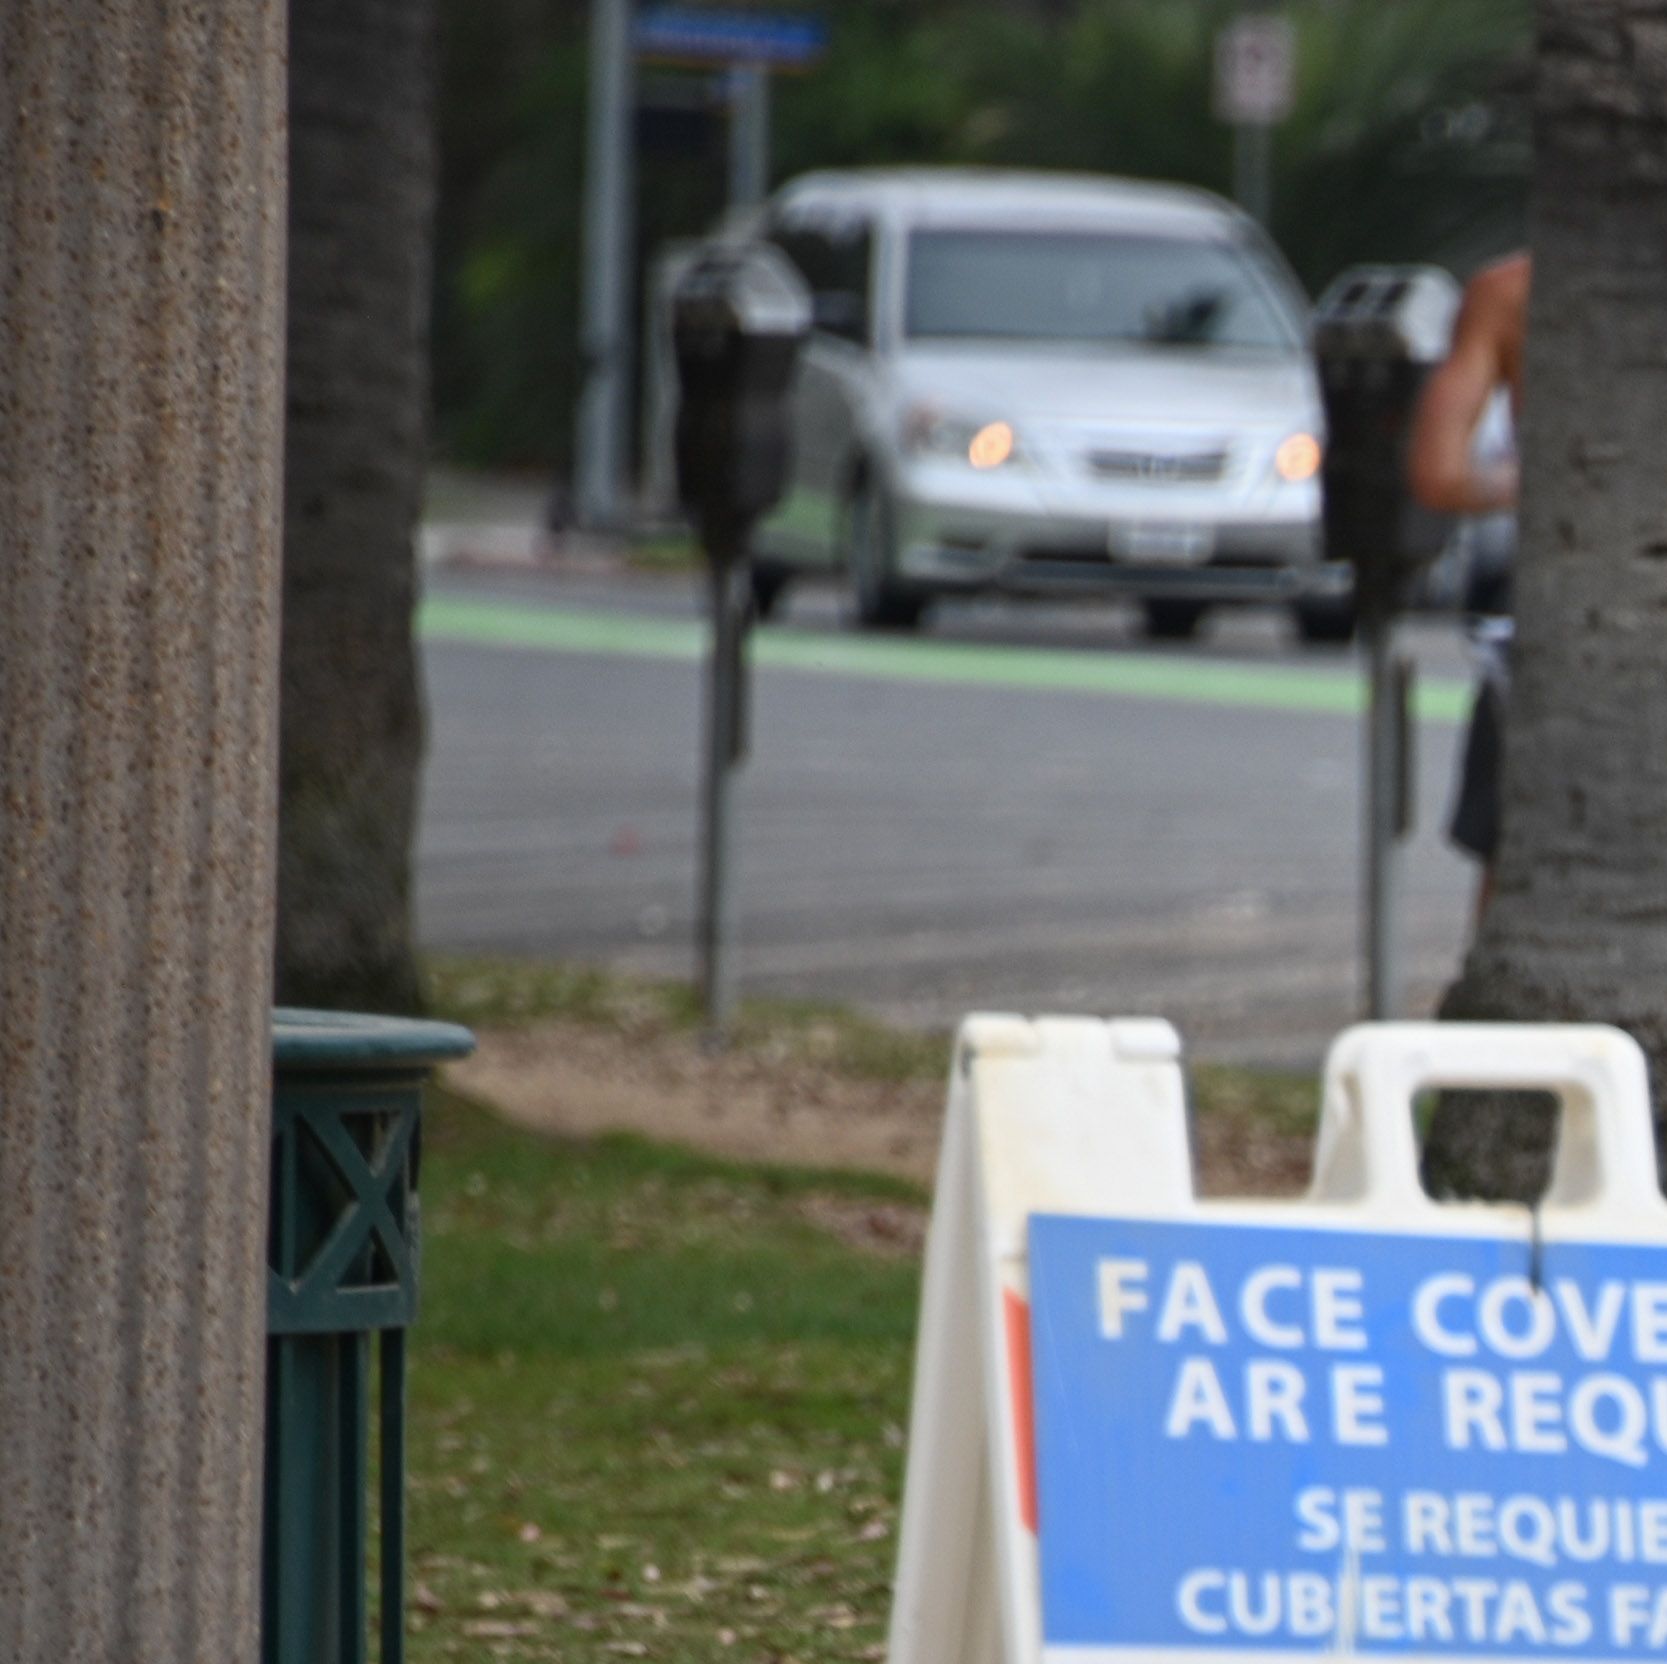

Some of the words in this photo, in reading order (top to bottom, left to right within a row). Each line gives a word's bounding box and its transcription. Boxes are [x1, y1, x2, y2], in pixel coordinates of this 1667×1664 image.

[1095, 1257, 1368, 1351] FACE
[1165, 1358, 1389, 1448] ARE
[1296, 1488, 1385, 1554] SE
[1177, 1568, 1592, 1648] CUBIERTAS
